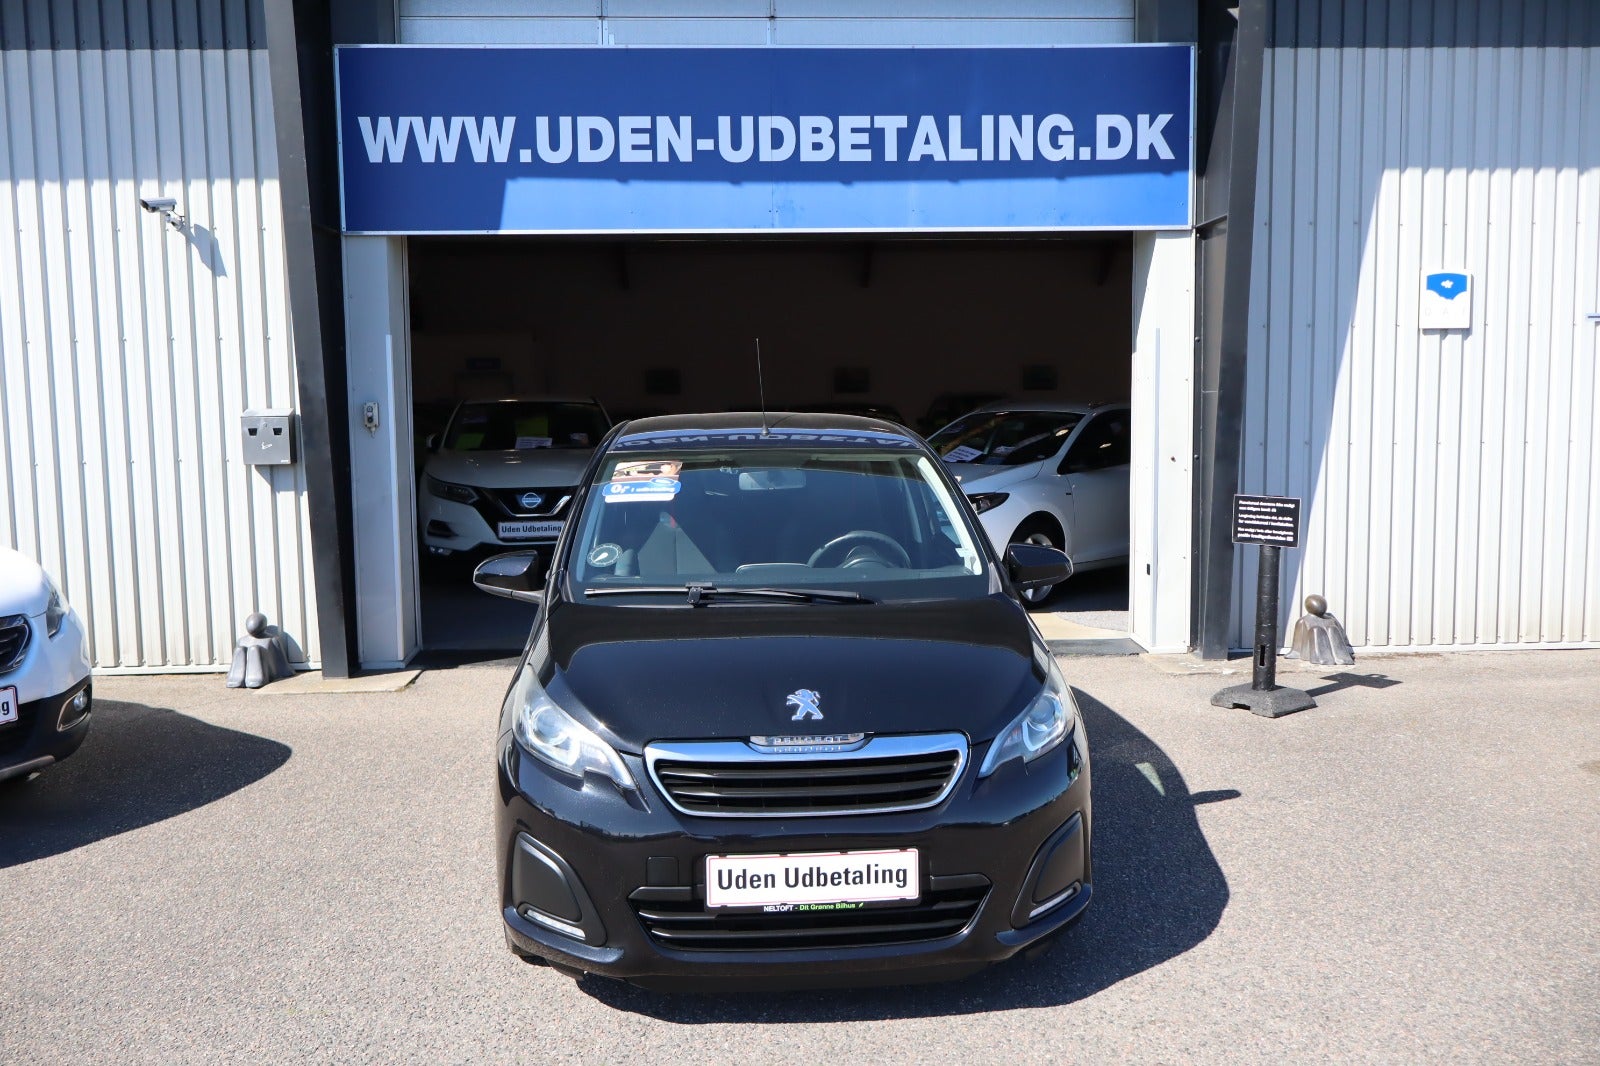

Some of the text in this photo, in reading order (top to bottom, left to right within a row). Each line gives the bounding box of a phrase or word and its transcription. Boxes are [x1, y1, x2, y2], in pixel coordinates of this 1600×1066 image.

[357, 113, 1175, 165] WWW.UDEN-UDBETALING.DK
[501, 525, 562, 534] Uden Udbetaling
[717, 863, 908, 890] Uden Udbetaling
